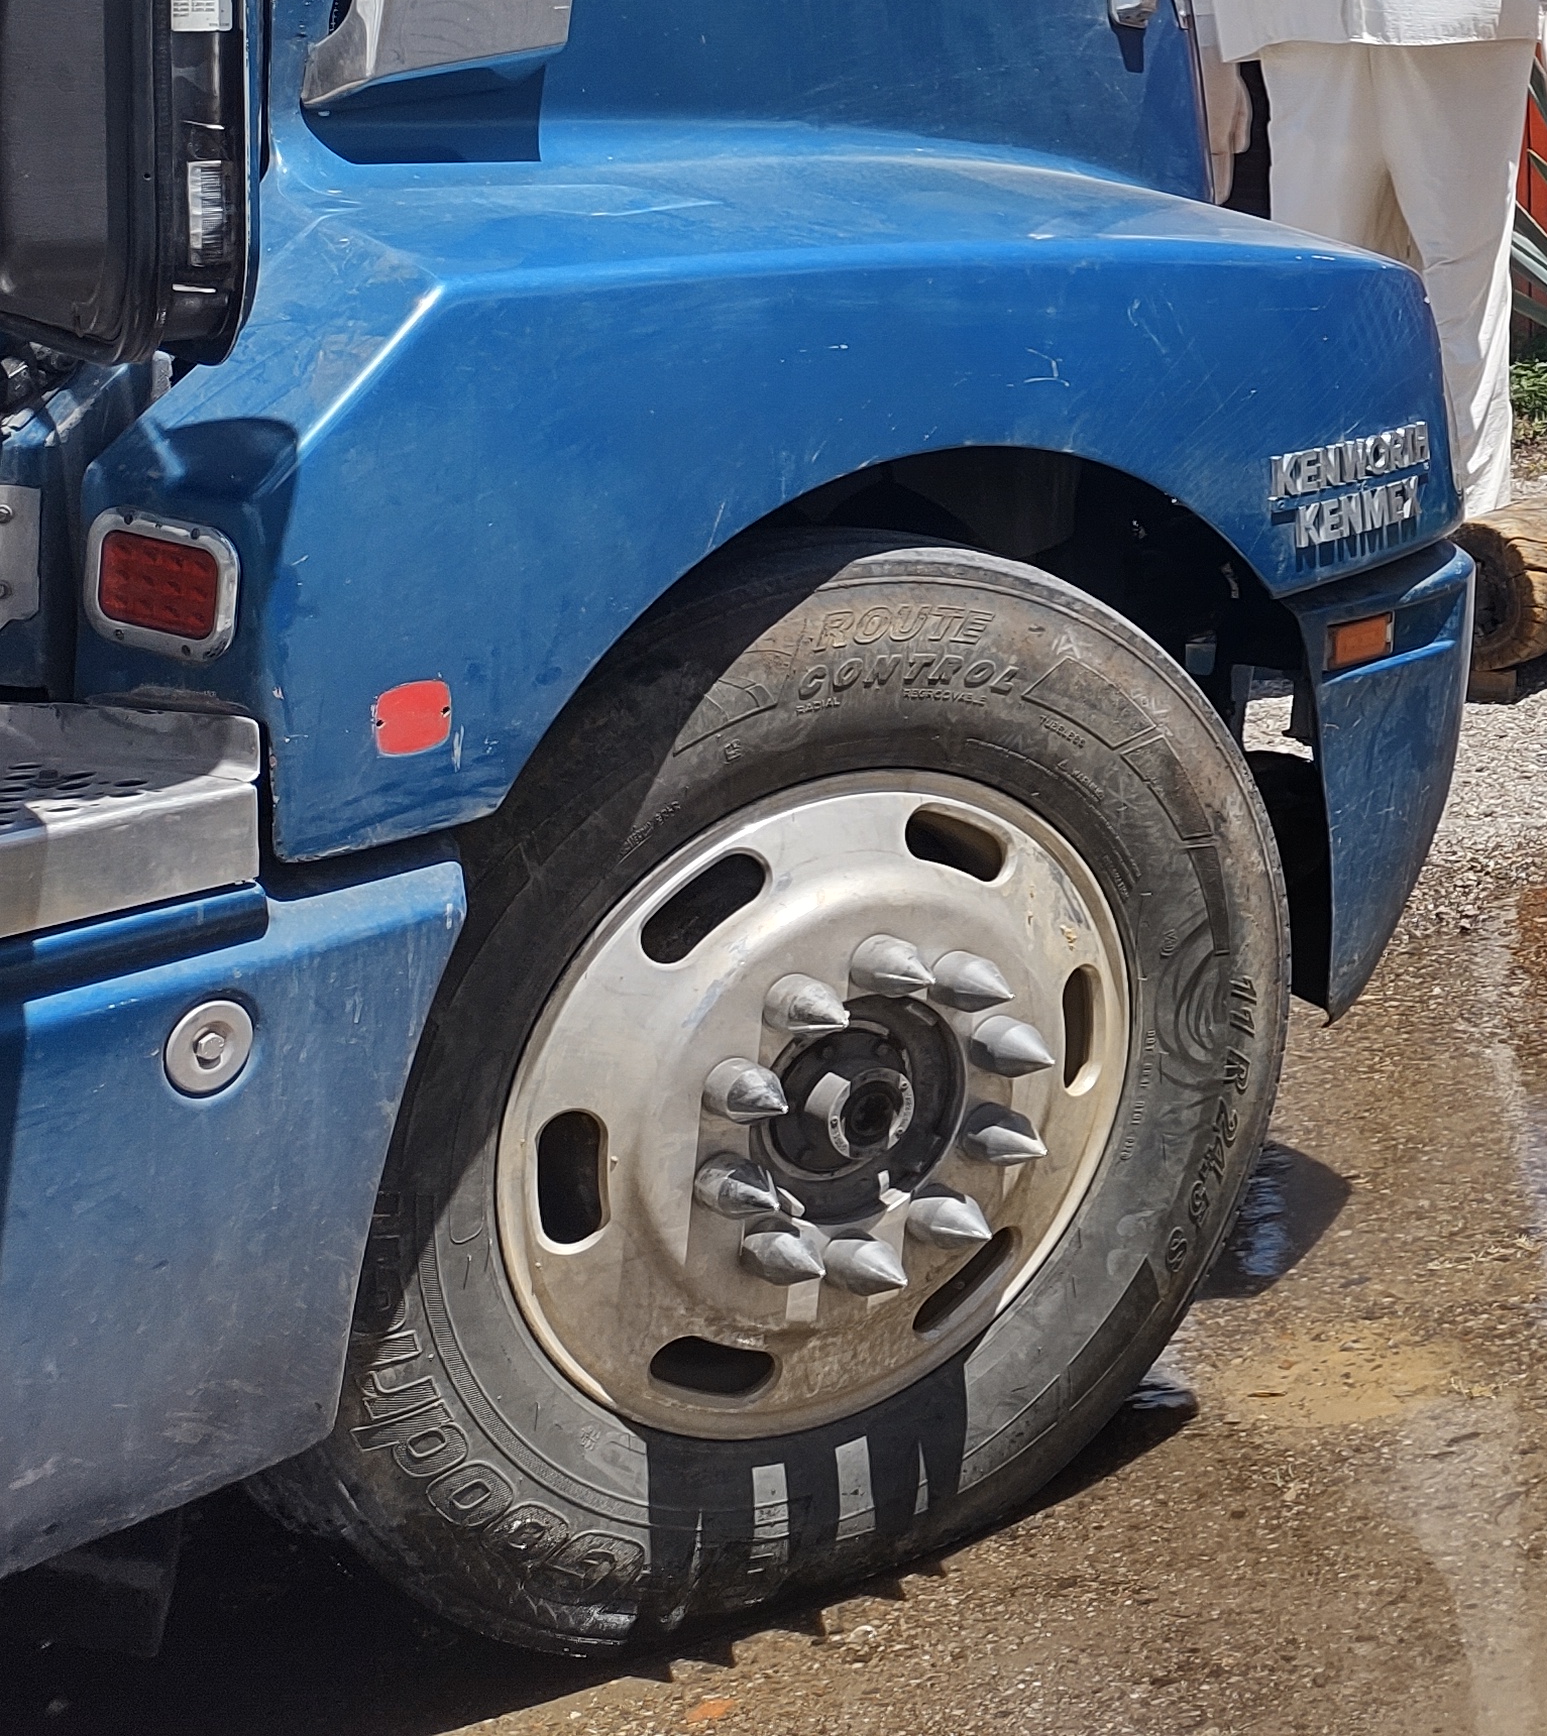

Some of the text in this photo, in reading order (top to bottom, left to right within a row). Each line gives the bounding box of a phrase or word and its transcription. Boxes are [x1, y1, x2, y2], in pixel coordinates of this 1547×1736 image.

[1269, 421, 1430, 498] KENWORTH
[1295, 476, 1421, 548] KENMEX
[812, 605, 995, 653] ROUTE
[797, 653, 1020, 701] CONTROL
[795, 697, 841, 715] RADIAL
